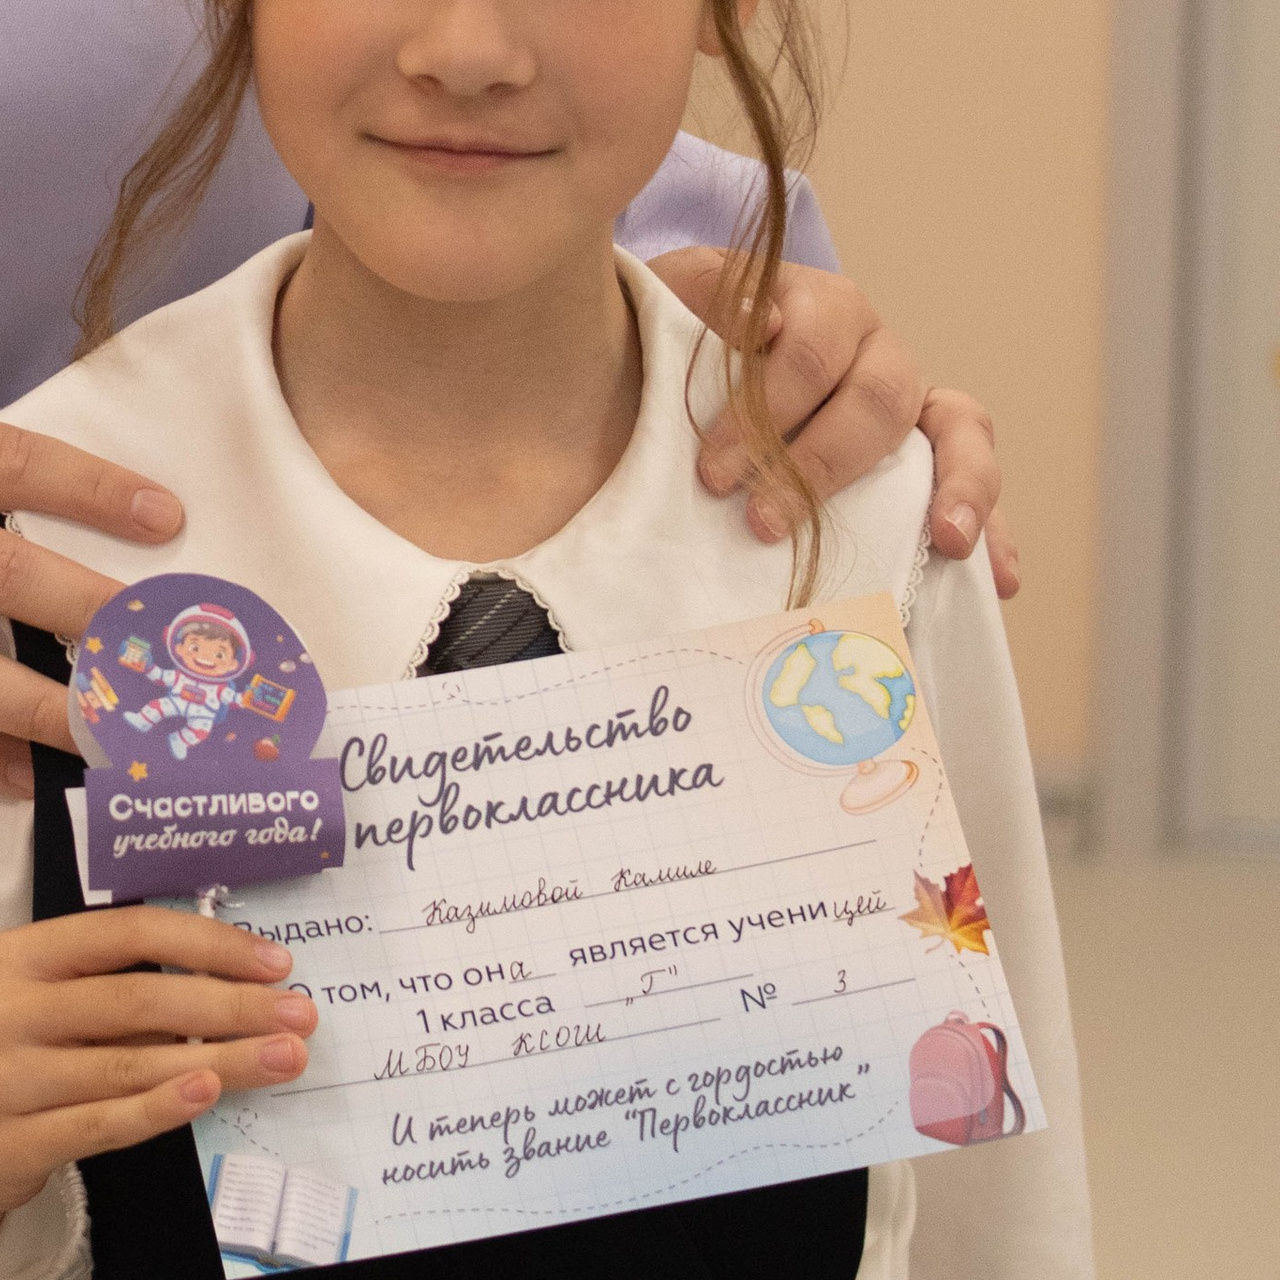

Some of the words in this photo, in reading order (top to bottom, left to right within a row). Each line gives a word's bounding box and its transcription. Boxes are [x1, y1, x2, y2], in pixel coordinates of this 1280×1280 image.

[339, 685, 692, 805] Свидетельство
[109, 789, 319, 821] Счастливого
[113, 824, 237, 858] учебного
[244, 817, 322, 845] года!
[354, 760, 724, 871] первоклассника
[421, 876, 583, 934] Казимовой
[612, 859, 717, 892] Камиле
[321, 981, 391, 1004] том,
[399, 968, 454, 995] что
[569, 923, 719, 967] является
[417, 1009, 430, 1034] 1
[440, 996, 556, 1032] класса
[740, 982, 778, 1013] №
[833, 969, 847, 994] 3
[373, 1041, 470, 1080] МБОУ
[511, 1023, 607, 1057] КСОШ
[392, 1111, 418, 1146] И
[428, 1105, 536, 1144] теперь
[548, 1078, 658, 1116] может
[666, 1078, 681, 1095] с
[687, 1045, 844, 1106] гордостью
[382, 1149, 491, 1185] носить
[502, 1126, 611, 1179] звание
